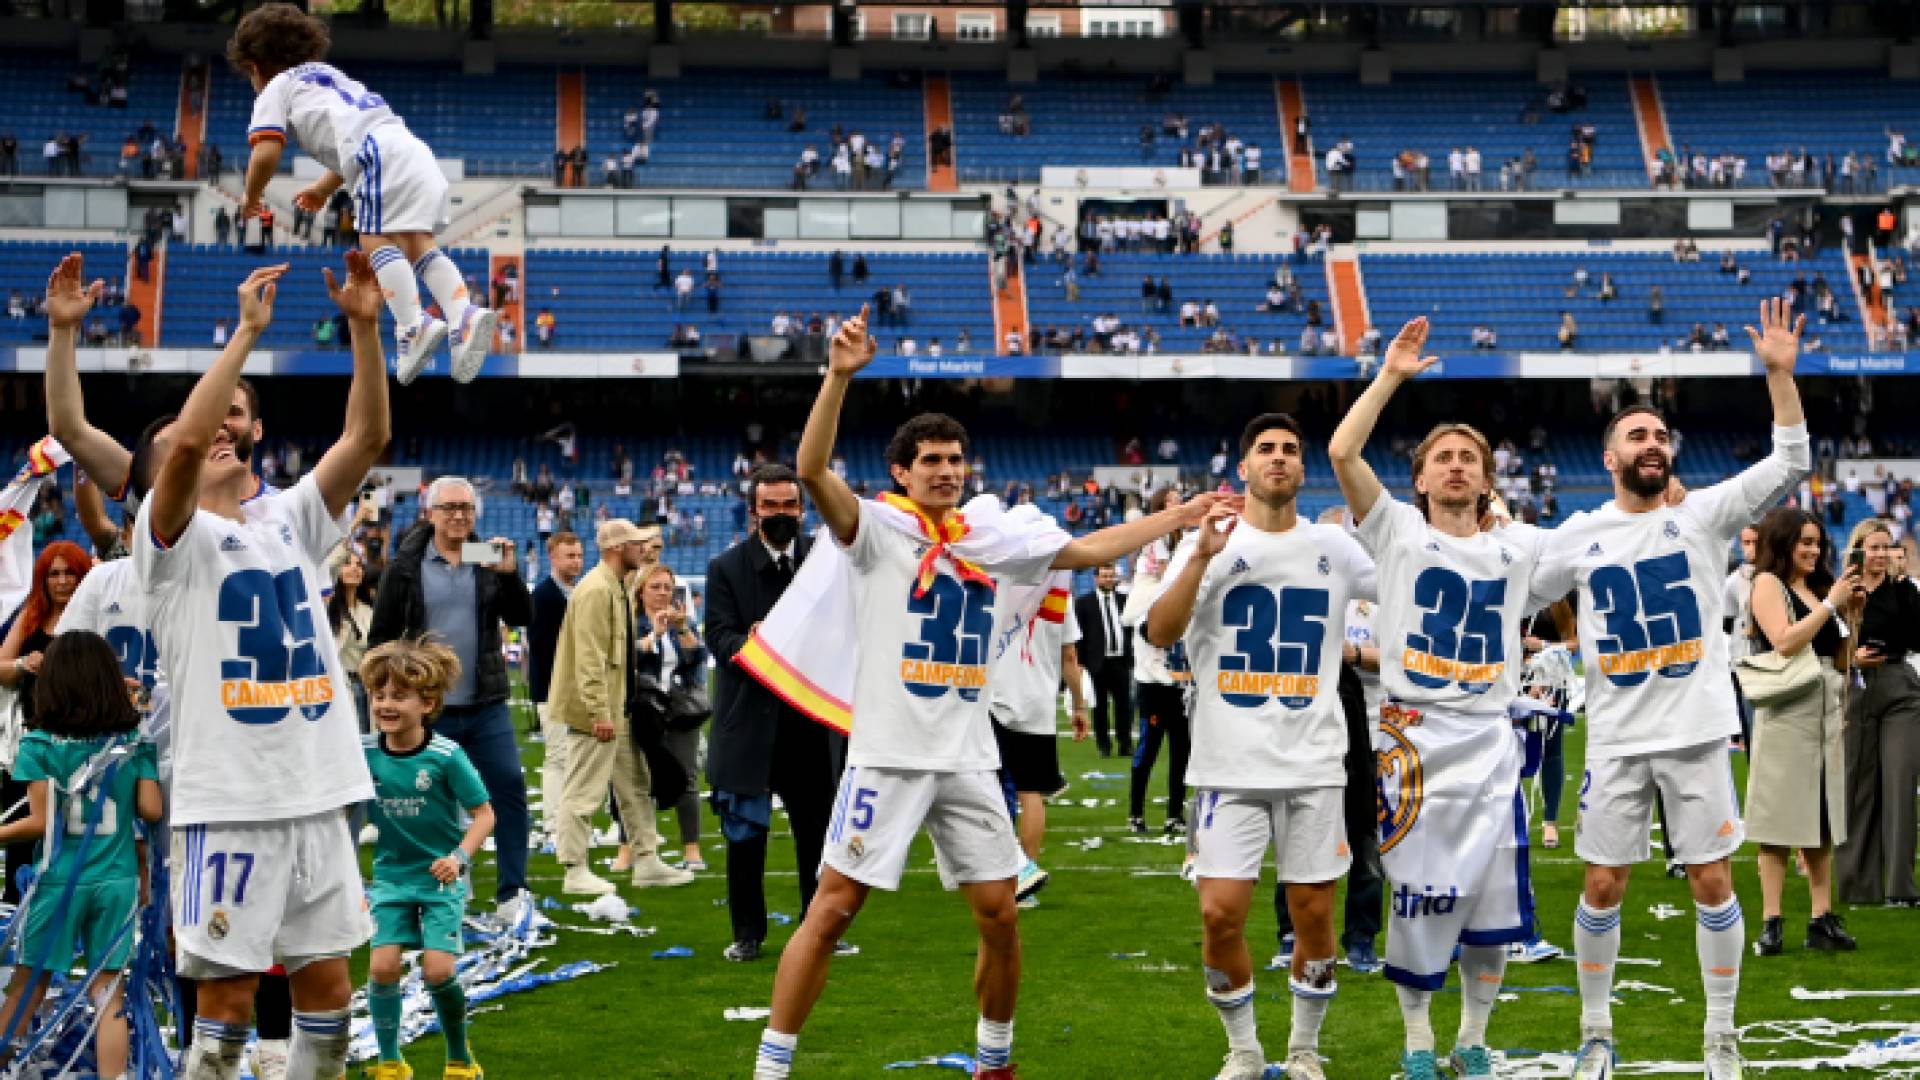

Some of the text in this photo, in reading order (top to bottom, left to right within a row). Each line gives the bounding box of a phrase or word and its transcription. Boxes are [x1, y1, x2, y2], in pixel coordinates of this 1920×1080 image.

[909, 359, 984, 373] Real Madrid
[1830, 356, 1905, 371] Real Madrid
[218, 566, 330, 725] 35
[903, 573, 996, 702] 35
[1218, 583, 1329, 710] 35
[1406, 566, 1507, 694] 35
[1588, 550, 1702, 687] 35
[1217, 671, 1319, 697] CAMPEONES
[851, 788, 878, 830] 5
[207, 850, 256, 906] 17
